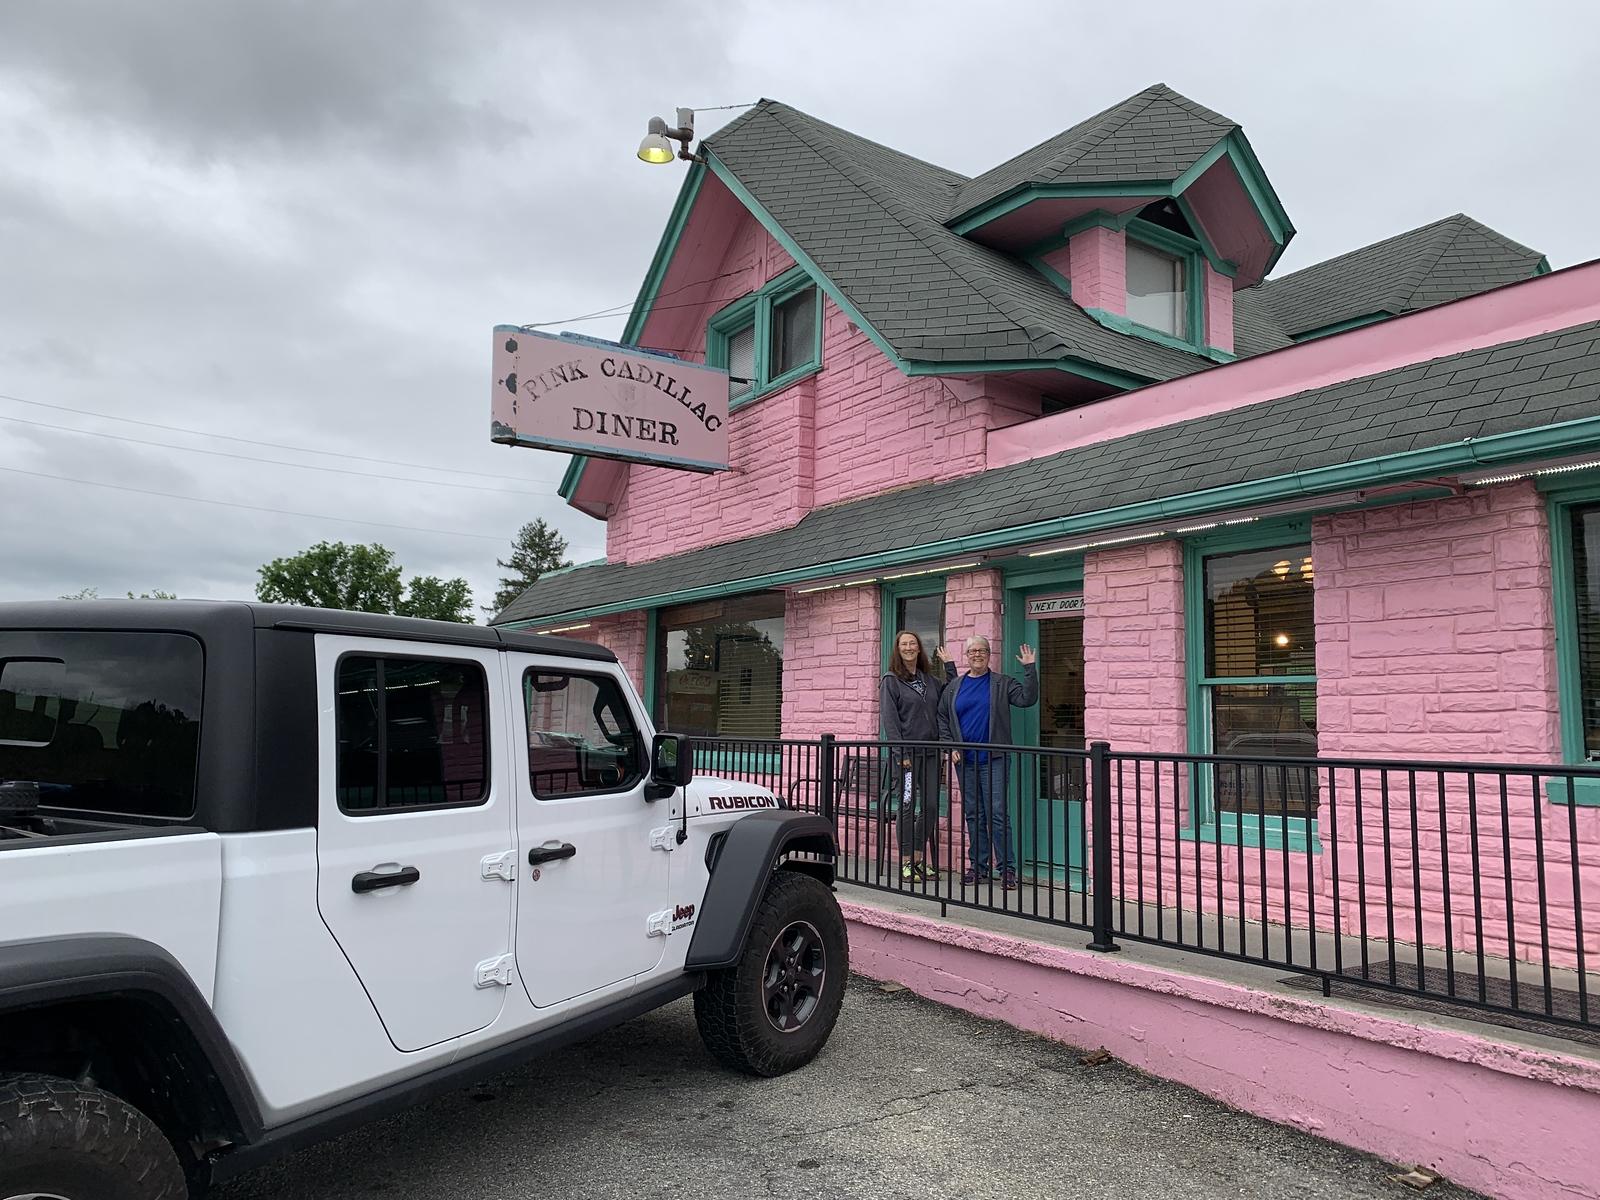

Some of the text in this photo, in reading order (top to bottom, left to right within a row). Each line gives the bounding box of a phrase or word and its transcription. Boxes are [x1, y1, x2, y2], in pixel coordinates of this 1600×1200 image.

[522, 358, 722, 432] PINK CADILLAC
[573, 407, 679, 446] DINER
[1034, 601, 1058, 611] NEXT
[708, 795, 776, 810] RUBICON
[672, 904, 695, 922] Jeep
